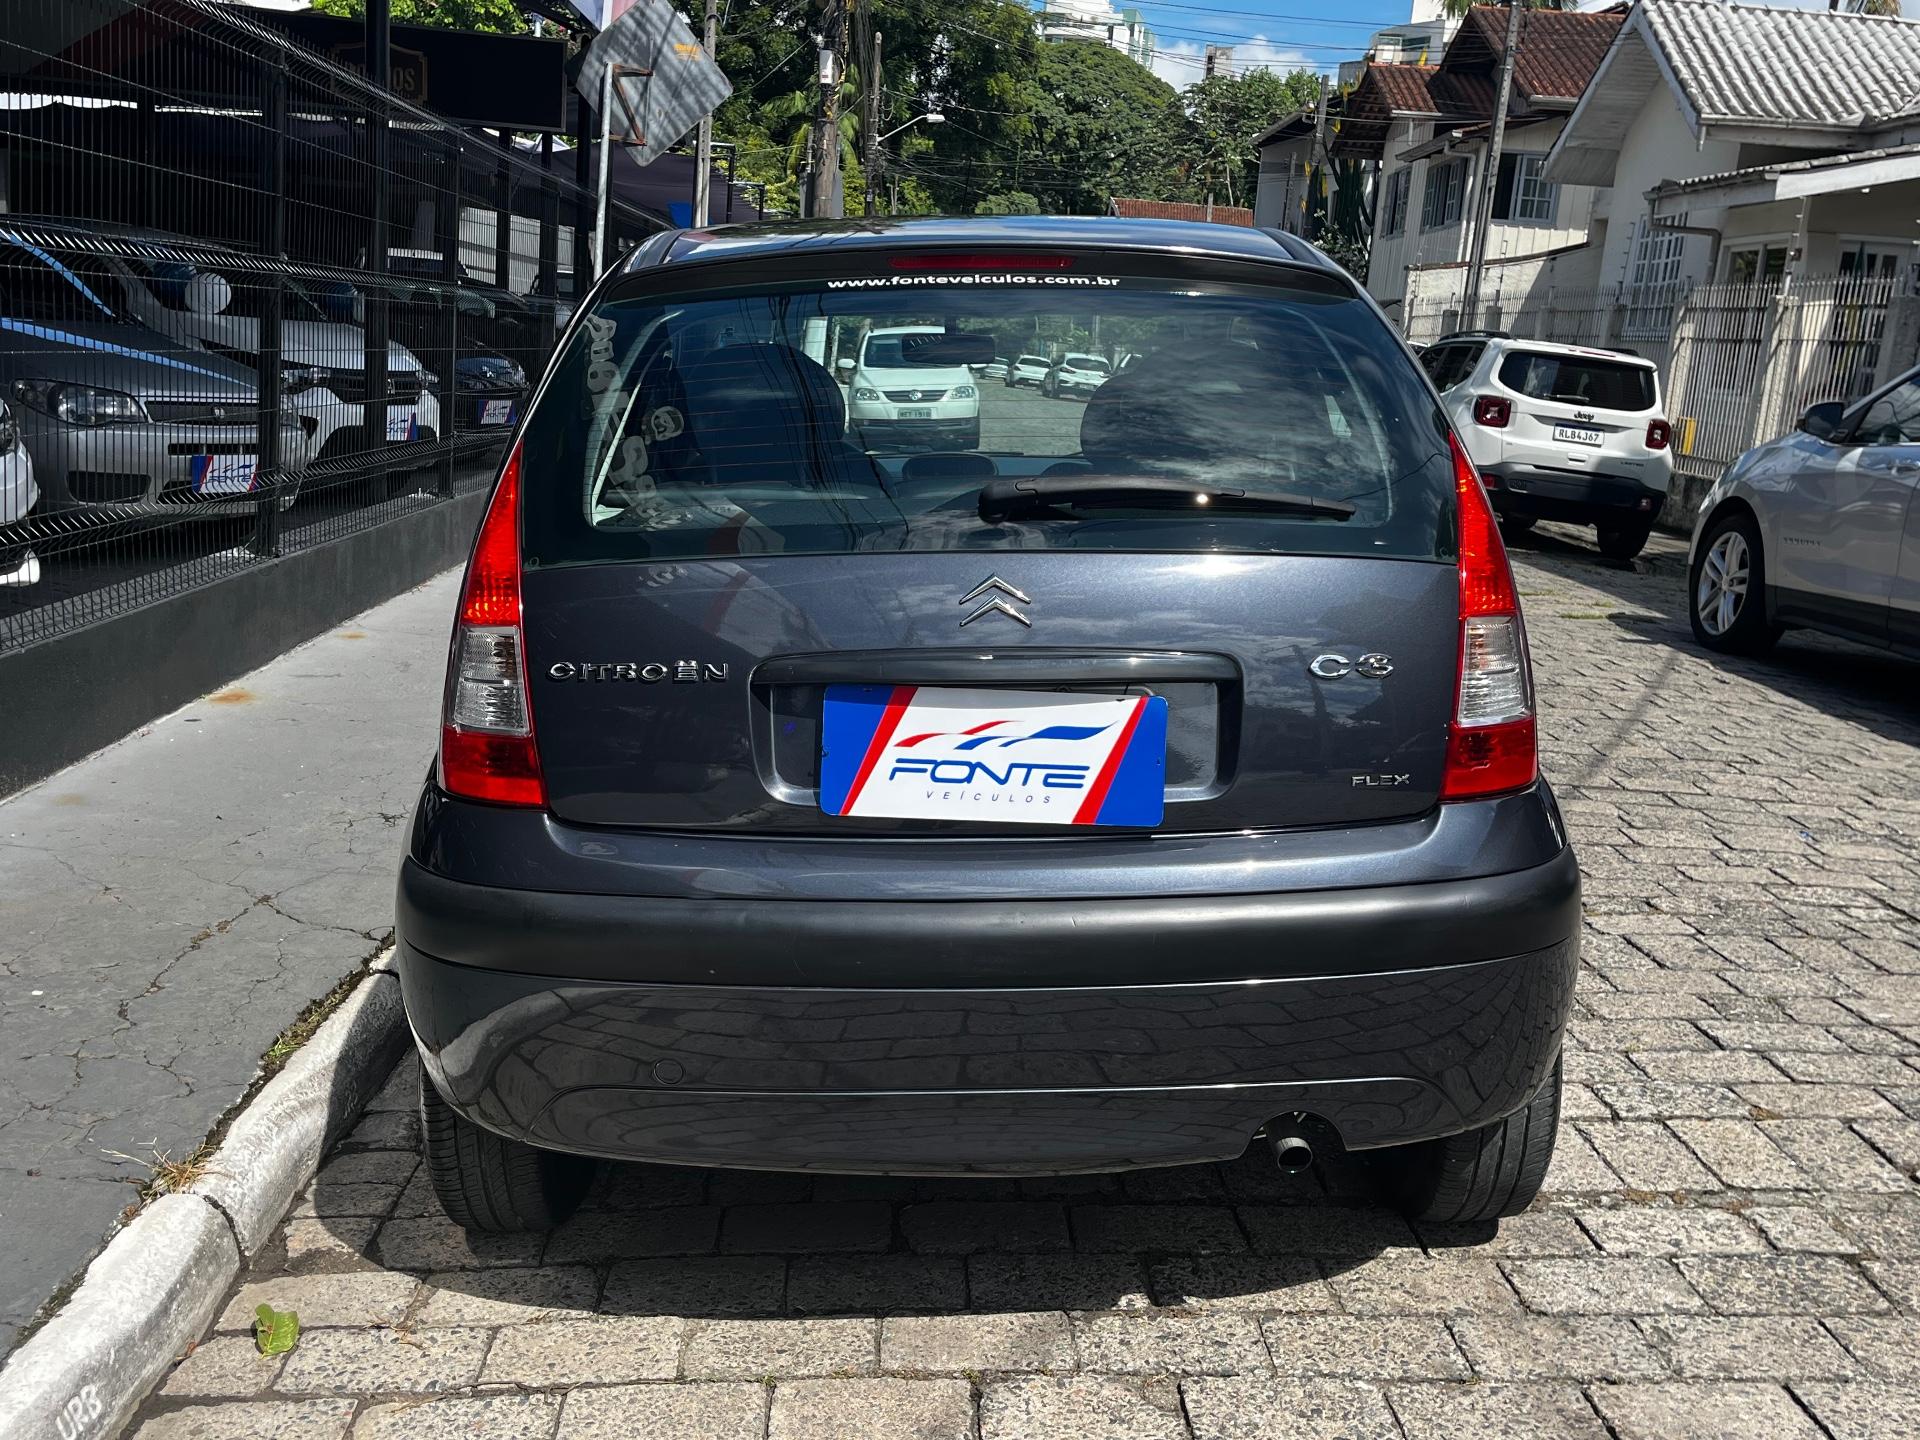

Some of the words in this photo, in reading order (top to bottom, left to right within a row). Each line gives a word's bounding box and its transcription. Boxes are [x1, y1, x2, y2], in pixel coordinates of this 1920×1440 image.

[827, 274, 1120, 288] www.fonteveiculos.com.br
[1559, 428, 1600, 443] RLB4J67
[549, 660, 729, 682] CITROËN
[1309, 652, 1394, 679] C3
[889, 757, 1091, 789] FONTE
[1352, 774, 1410, 787] FLEX
[926, 790, 1051, 804] VEÍCULOS
[55, 1384, 102, 1440] URB
